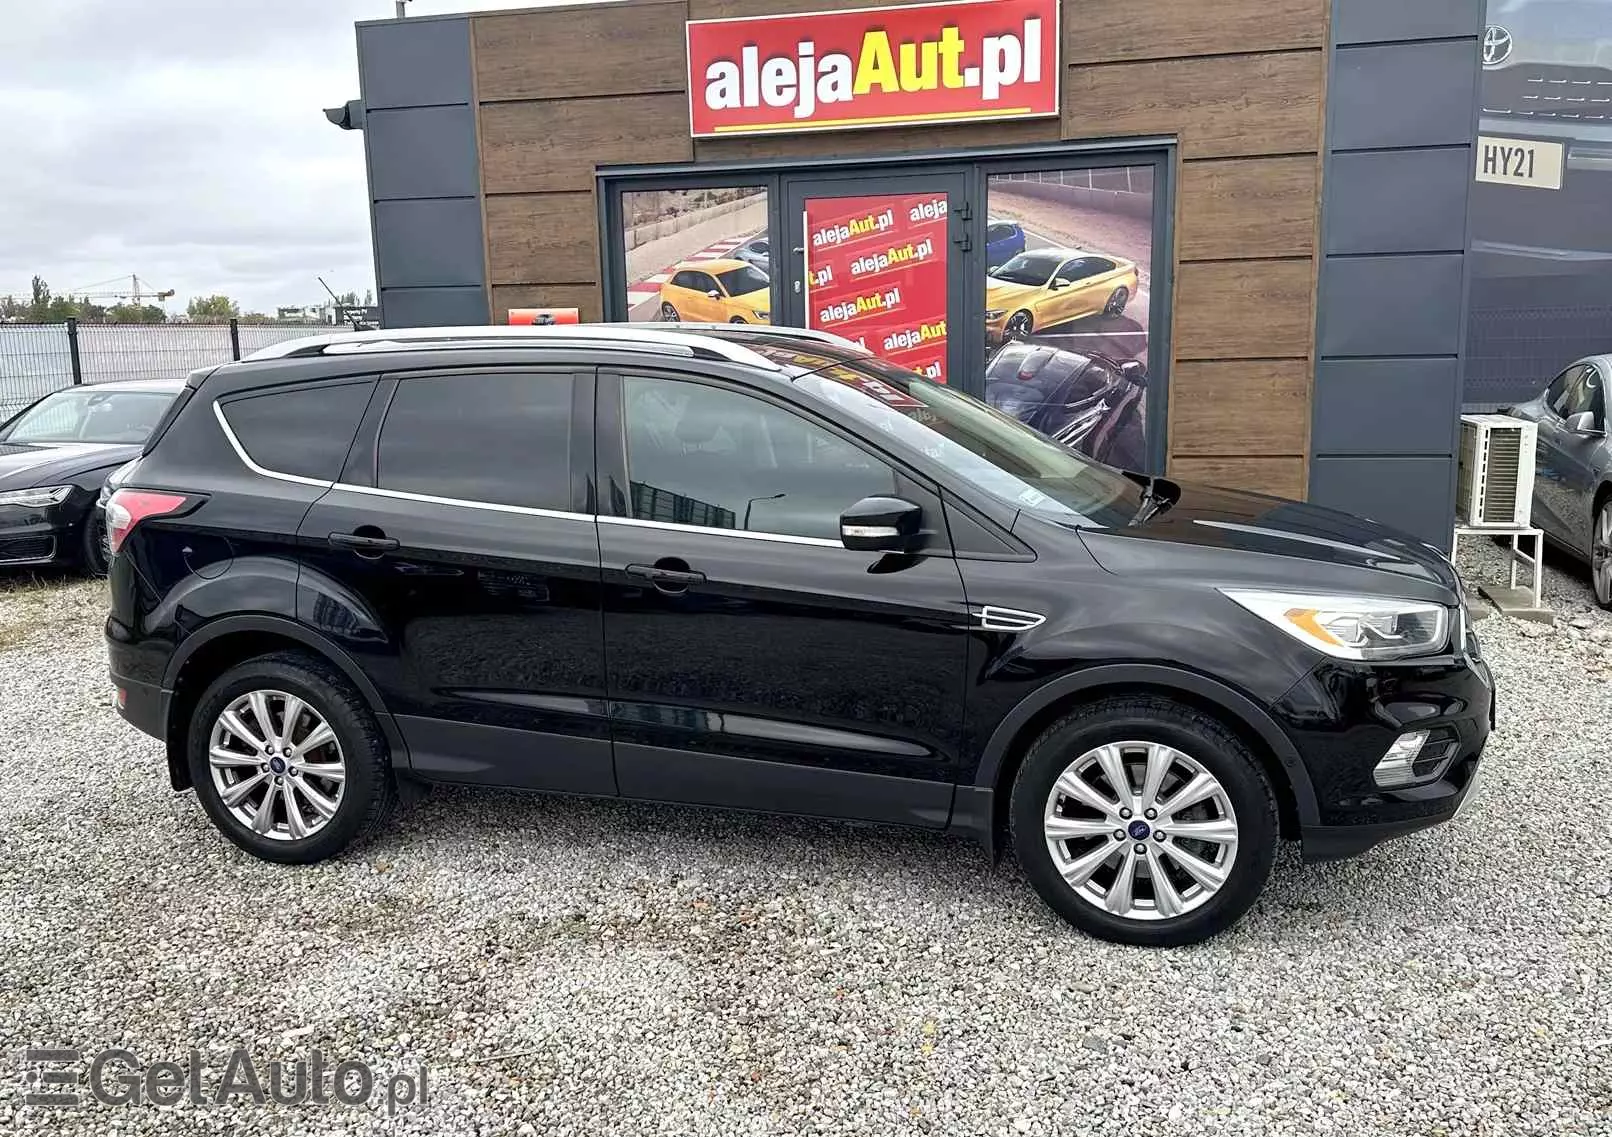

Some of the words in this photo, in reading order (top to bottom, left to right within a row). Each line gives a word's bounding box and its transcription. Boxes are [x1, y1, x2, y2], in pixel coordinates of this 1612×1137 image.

[705, 19, 1042, 119] alejaAut.pl
[1483, 144, 1535, 178] HY21
[812, 209, 894, 247] alejaAut.pl
[909, 199, 947, 221] aleja
[850, 239, 933, 275] alejaAut.pl
[820, 287, 900, 323] alejaAut.pl
